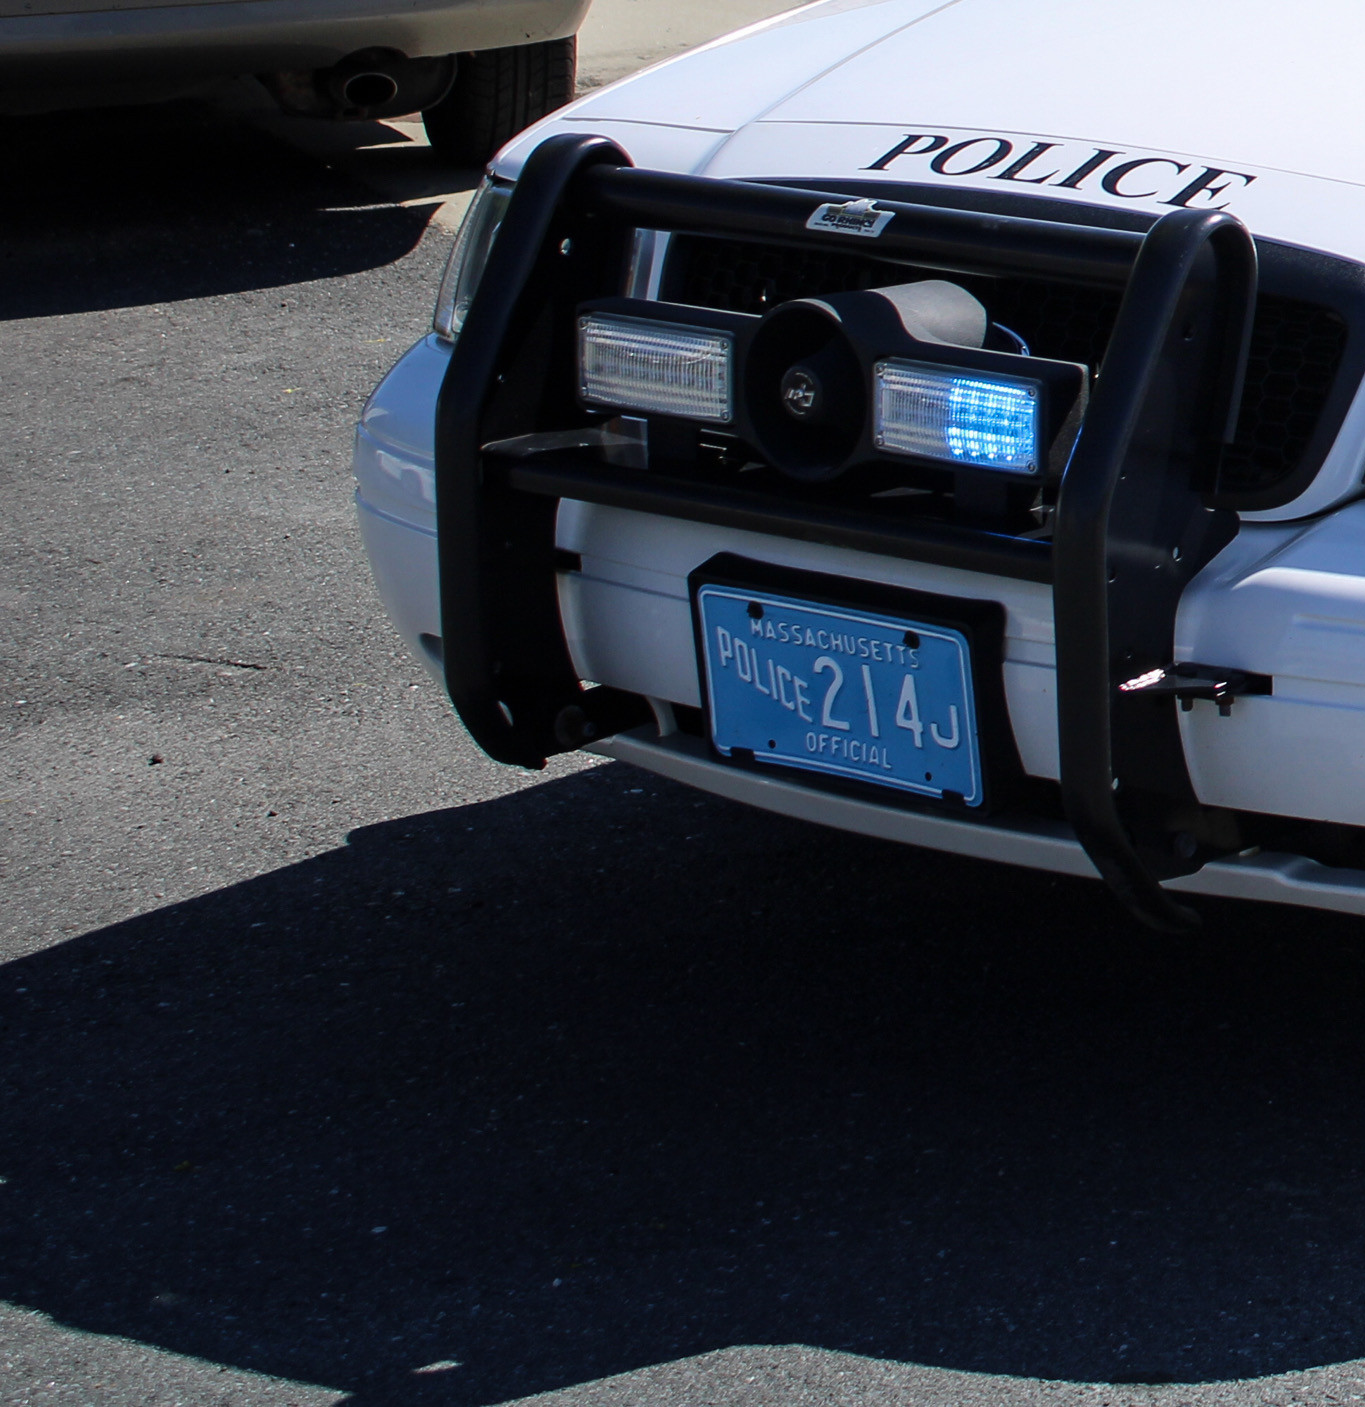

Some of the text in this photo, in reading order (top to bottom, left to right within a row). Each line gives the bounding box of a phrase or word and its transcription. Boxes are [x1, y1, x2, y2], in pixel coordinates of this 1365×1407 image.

[857, 133, 1258, 211] POLICE
[716, 625, 813, 724] POLICE
[750, 618, 920, 669] MASSACHUSETTS
[806, 731, 892, 770] OFFICIAL
